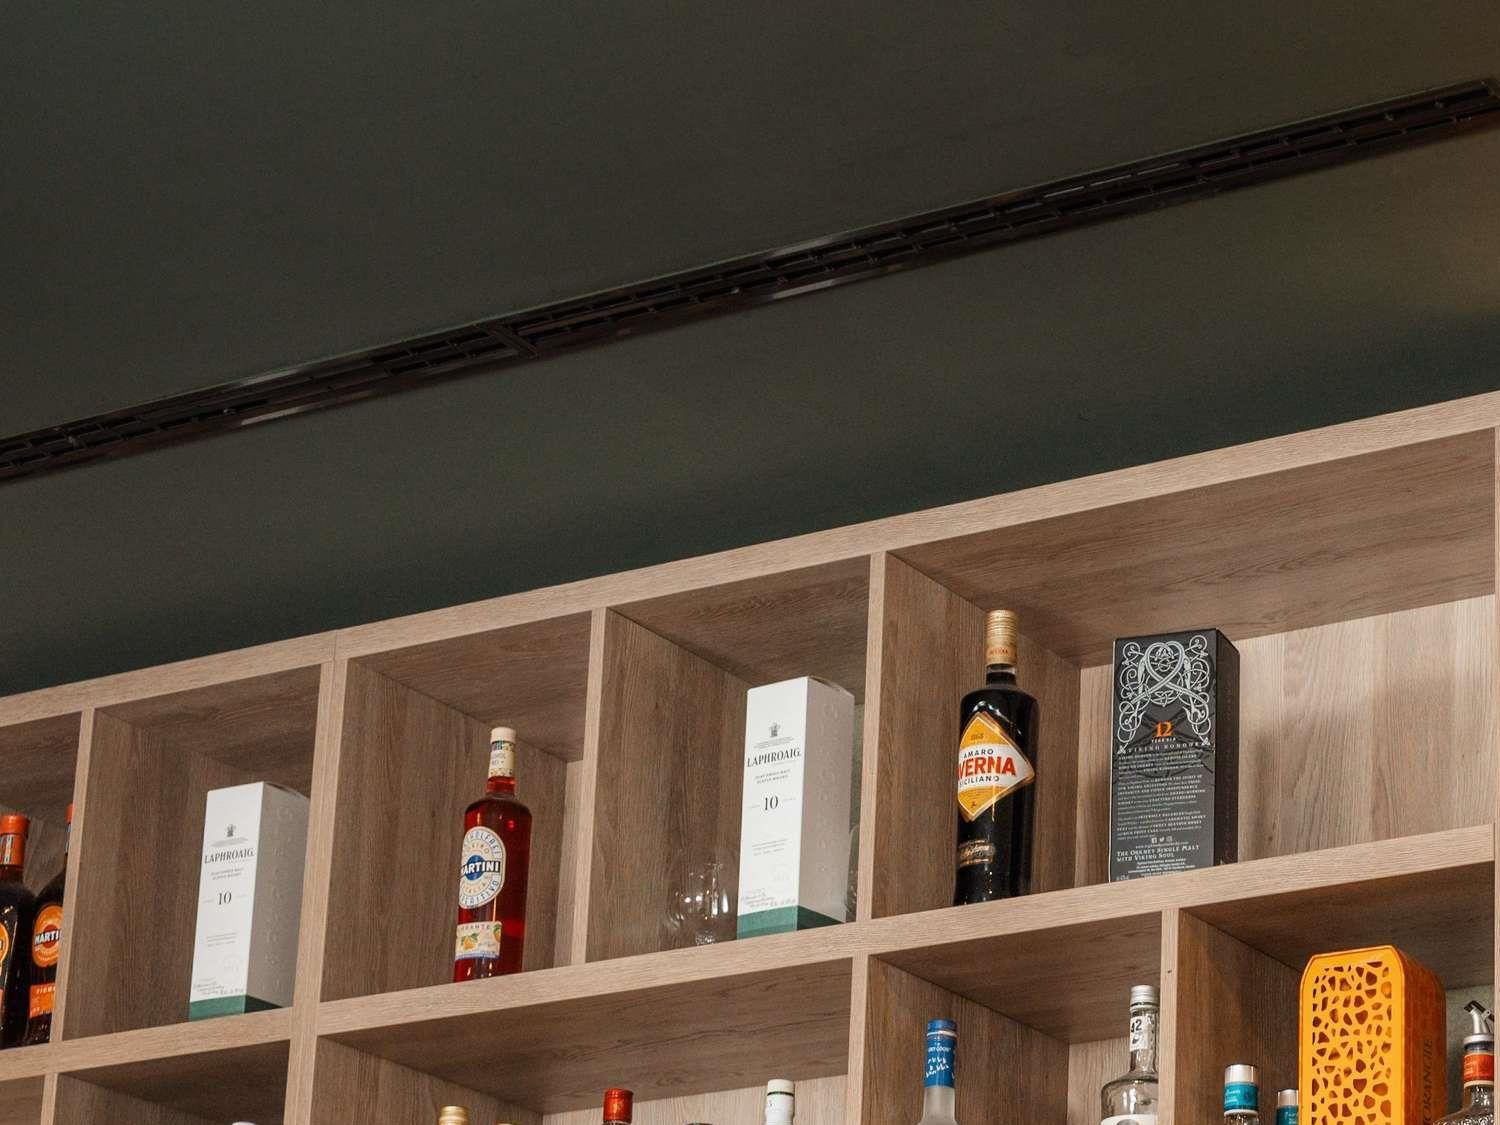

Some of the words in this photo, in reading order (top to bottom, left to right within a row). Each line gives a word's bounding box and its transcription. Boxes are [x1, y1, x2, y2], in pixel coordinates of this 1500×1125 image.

[1155, 720, 1174, 738] 12
[963, 748, 995, 759] AMARO
[958, 756, 1017, 780] VERNA
[764, 795, 780, 811] 10
[216, 891, 233, 906] 10
